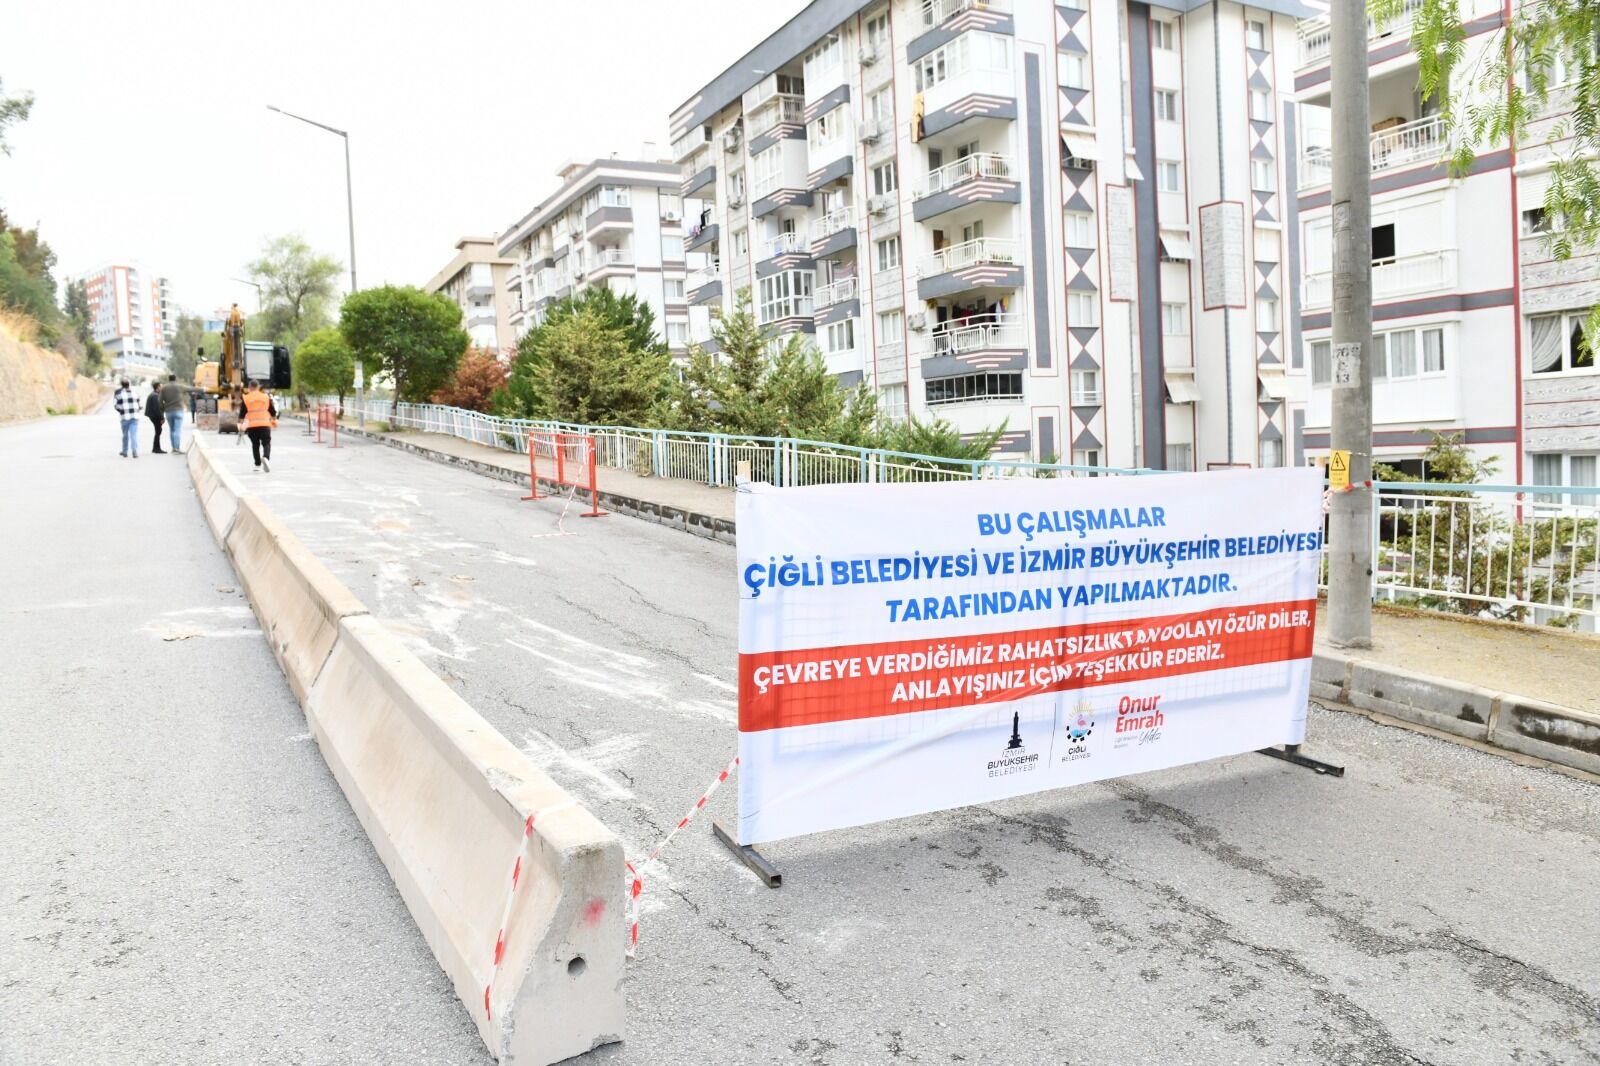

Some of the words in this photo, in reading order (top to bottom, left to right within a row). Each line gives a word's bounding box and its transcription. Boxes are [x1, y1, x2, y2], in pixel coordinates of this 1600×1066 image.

[977, 512, 1011, 536] BU
[1017, 506, 1166, 541] ÇALIŞMALAR
[744, 554, 824, 598] ÇİĞLİ
[830, 547, 978, 586] BELEDİYESİ
[983, 552, 1014, 575] VE
[1020, 541, 1084, 574] İZMİR
[1090, 534, 1220, 569] BÜYÜKŞEHİR
[1225, 526, 1322, 558] BELEDİYESİ
[886, 588, 1052, 623] TARAFINDAN
[1058, 573, 1238, 608] YAPILMAKTADIR.
[753, 657, 861, 695] ÇEVREYE
[866, 642, 993, 676] VERDİĞİMİZ
[999, 627, 1161, 662] RAHATSIZLIKTAN
[1160, 618, 1222, 641] DOLAYI
[1224, 610, 1266, 634] ÖZÜR
[1268, 608, 1311, 630] DİLER,
[891, 669, 1025, 703] ANLAYIŞINIZ
[1029, 661, 1072, 690] İÇİN
[1076, 647, 1162, 681] TEŞEKKÜR
[1166, 640, 1225, 666] EDERİZ.
[1115, 710, 1164, 733] Emrah
[1119, 695, 1161, 715] Onur
